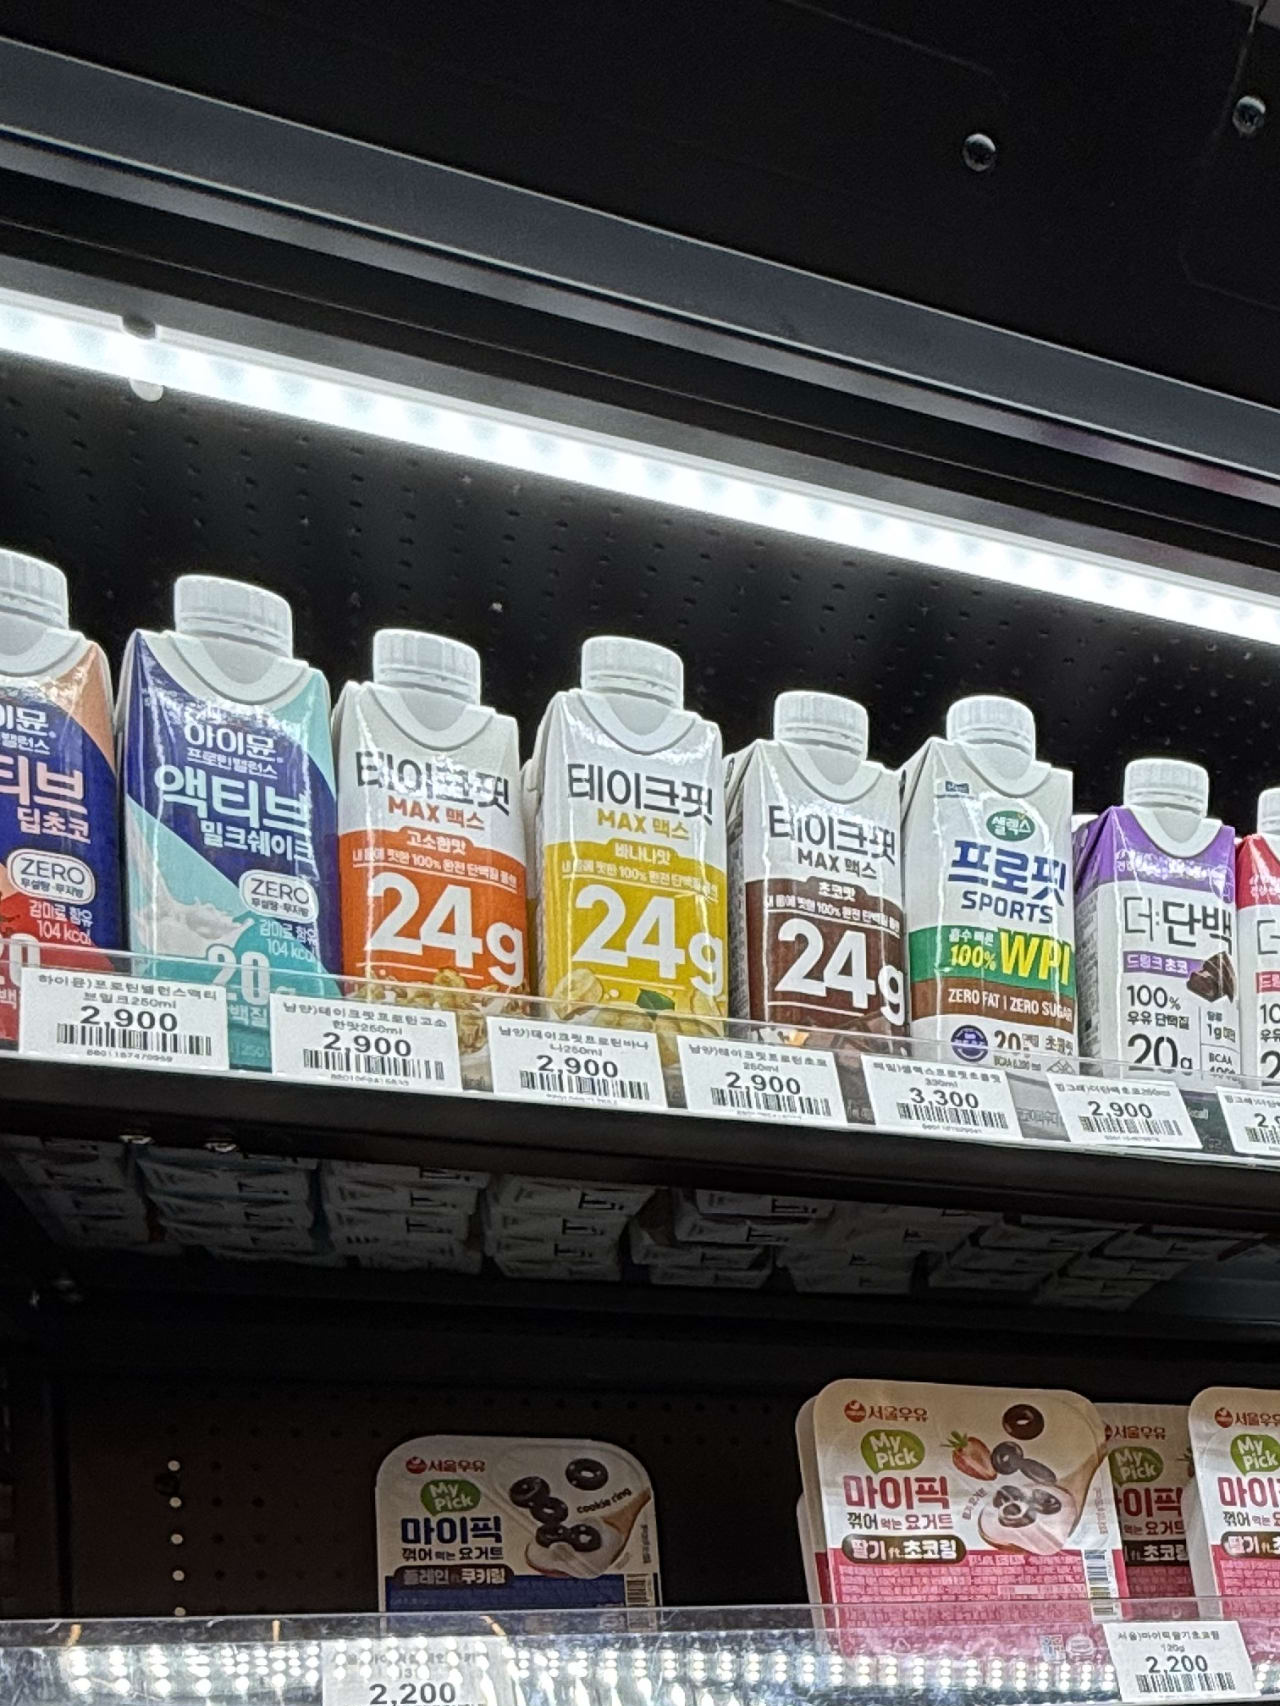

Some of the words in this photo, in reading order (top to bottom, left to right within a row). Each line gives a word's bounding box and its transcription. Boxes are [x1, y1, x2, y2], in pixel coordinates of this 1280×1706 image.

[155, 764, 312, 836] 액티브
[567, 764, 713, 826] 테이크핏
[18, 806, 91, 844] 딥초코
[388, 795, 440, 823] MAX
[446, 807, 485, 831] 맥스
[597, 808, 647, 834] MAX
[652, 817, 689, 840] 맥스
[201, 819, 315, 864] 밀크쉐이크
[768, 805, 896, 866] 테이크핏
[615, 843, 671, 865] 바나나맛
[798, 848, 840, 872] MAX
[845, 859, 877, 879] 맥스
[21, 857, 85, 885] ZERO
[948, 839, 1067, 907] 프로핏
[251, 878, 311, 905] ZERO
[961, 890, 1053, 924] SPORTS
[363, 872, 525, 988] 24g
[572, 884, 724, 996] 24g
[950, 943, 997, 971] 100%
[998, 928, 1072, 987] WPI
[775, 918, 905, 1026] 24g
[80, 1005, 178, 1032] 2,900
[948, 988, 980, 1005] ZERO
[982, 991, 1001, 1009] FAT
[1010, 994, 1039, 1015] ZERO
[1041, 999, 1073, 1022] SUGAR
[1127, 1010, 1152, 1024] 우유
[322, 1032, 412, 1057] 2,900
[536, 1054, 618, 1078] 2,900
[725, 1071, 801, 1095] 2,900
[909, 1087, 979, 1109] 3,300
[1087, 1100, 1153, 1119] 2,900
[867, 1404, 929, 1423] 서울우유
[869, 1430, 902, 1453] My
[1236, 1438, 1264, 1457] My
[428, 1458, 486, 1474] 서울우유
[875, 1450, 916, 1470] Pick
[1243, 1453, 1279, 1470] Pick
[843, 1475, 951, 1510] 마이픽
[400, 1516, 503, 1545] 마이픽
[904, 1513, 954, 1531] 요거트
[402, 1547, 433, 1562] 꺾어
[459, 1546, 504, 1561] 요거트
[1145, 1655, 1208, 1674] 2,200
[369, 1683, 457, 1706] 2,200
